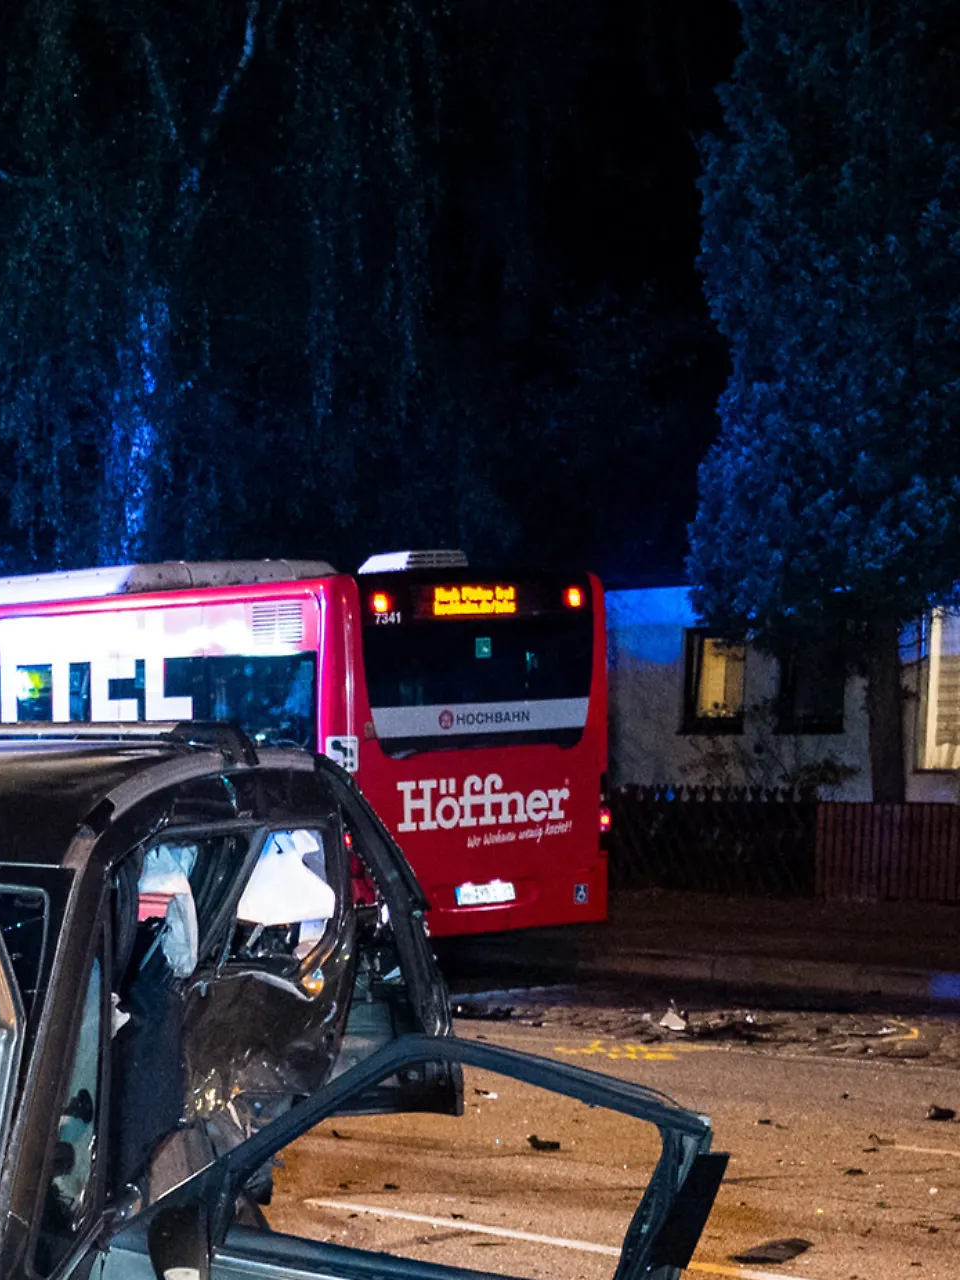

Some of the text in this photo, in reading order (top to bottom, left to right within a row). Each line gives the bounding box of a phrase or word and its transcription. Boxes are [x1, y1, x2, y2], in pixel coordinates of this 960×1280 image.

[374, 612, 401, 625] 7341
[456, 710, 530, 726] HOCHBAHN
[397, 773, 570, 833] Höffner
